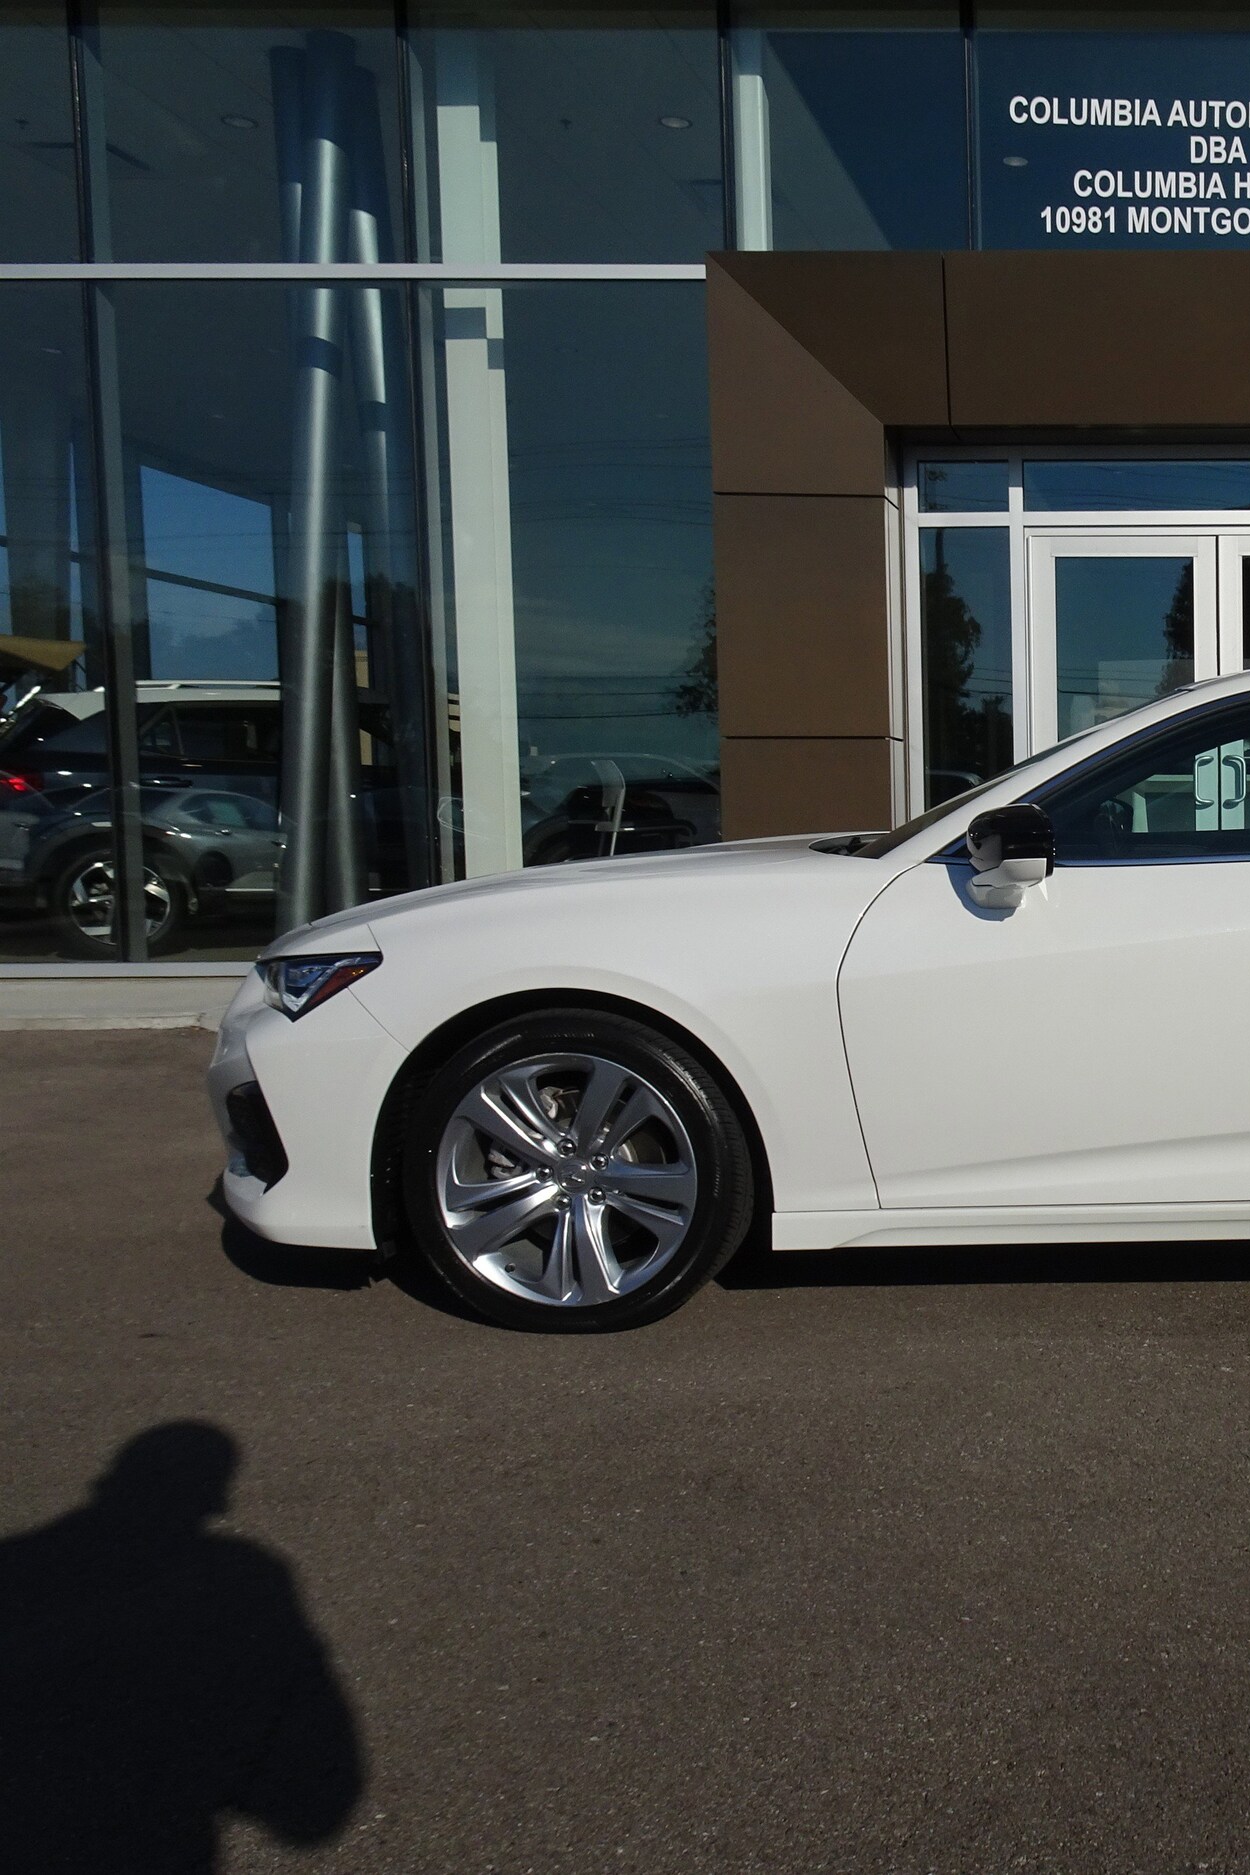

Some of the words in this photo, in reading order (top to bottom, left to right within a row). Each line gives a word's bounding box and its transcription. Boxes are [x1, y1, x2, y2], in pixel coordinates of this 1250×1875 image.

[1009, 95, 1162, 127] COLUMBIA
[1190, 135, 1248, 164] DBA
[1073, 169, 1227, 200] COLUMBIA
[1040, 205, 1116, 234] 10981
